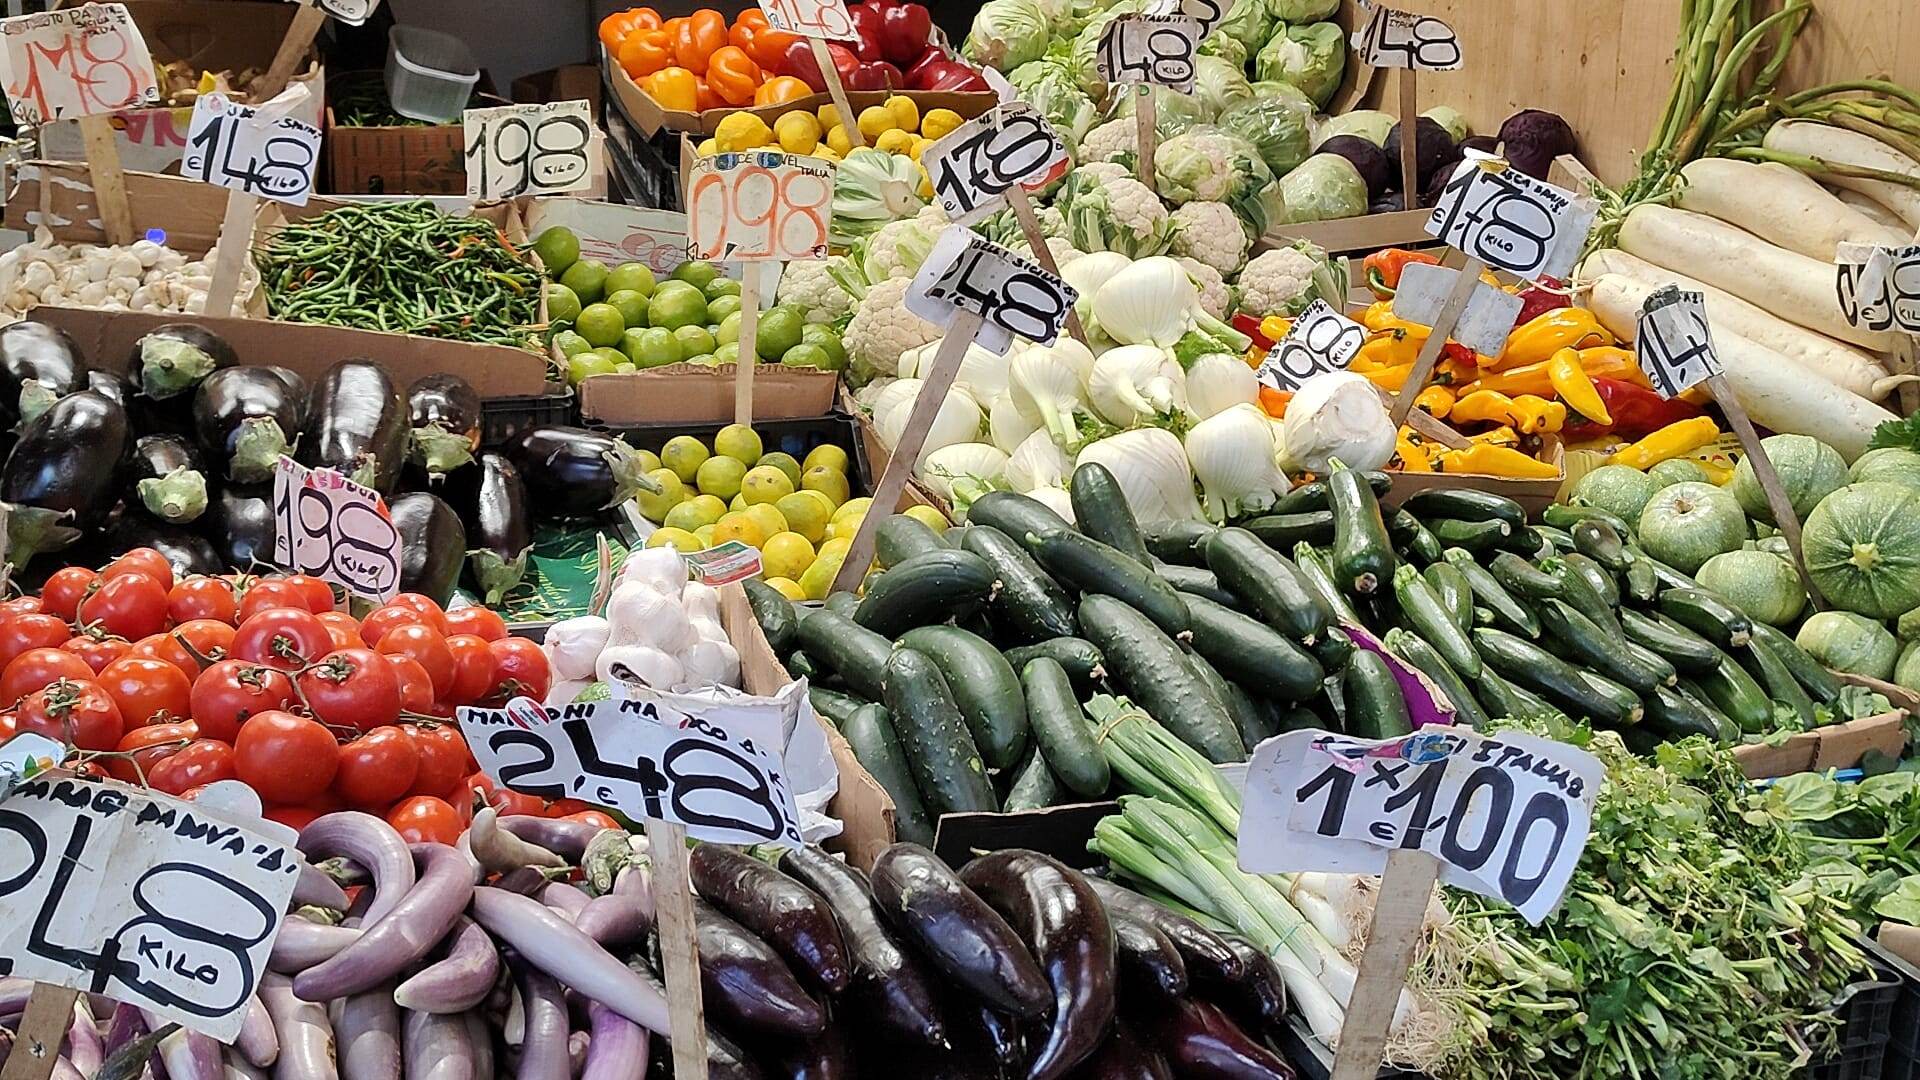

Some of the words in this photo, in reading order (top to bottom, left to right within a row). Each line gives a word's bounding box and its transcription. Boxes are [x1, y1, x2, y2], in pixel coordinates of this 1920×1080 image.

[1097, 20, 1193, 83] 1,48
[1160, 66, 1185, 74] KILO
[191, 114, 314, 197] 1,48
[465, 114, 590, 200] 1,98
[542, 162, 576, 175] KILO
[1445, 165, 1556, 272] 1,78
[1484, 233, 1514, 253] KILO
[1332, 340, 1353, 363] KILO
[277, 476, 398, 595] 1,98
[488, 719, 785, 842] 2,48
[137, 934, 219, 985] KILO
